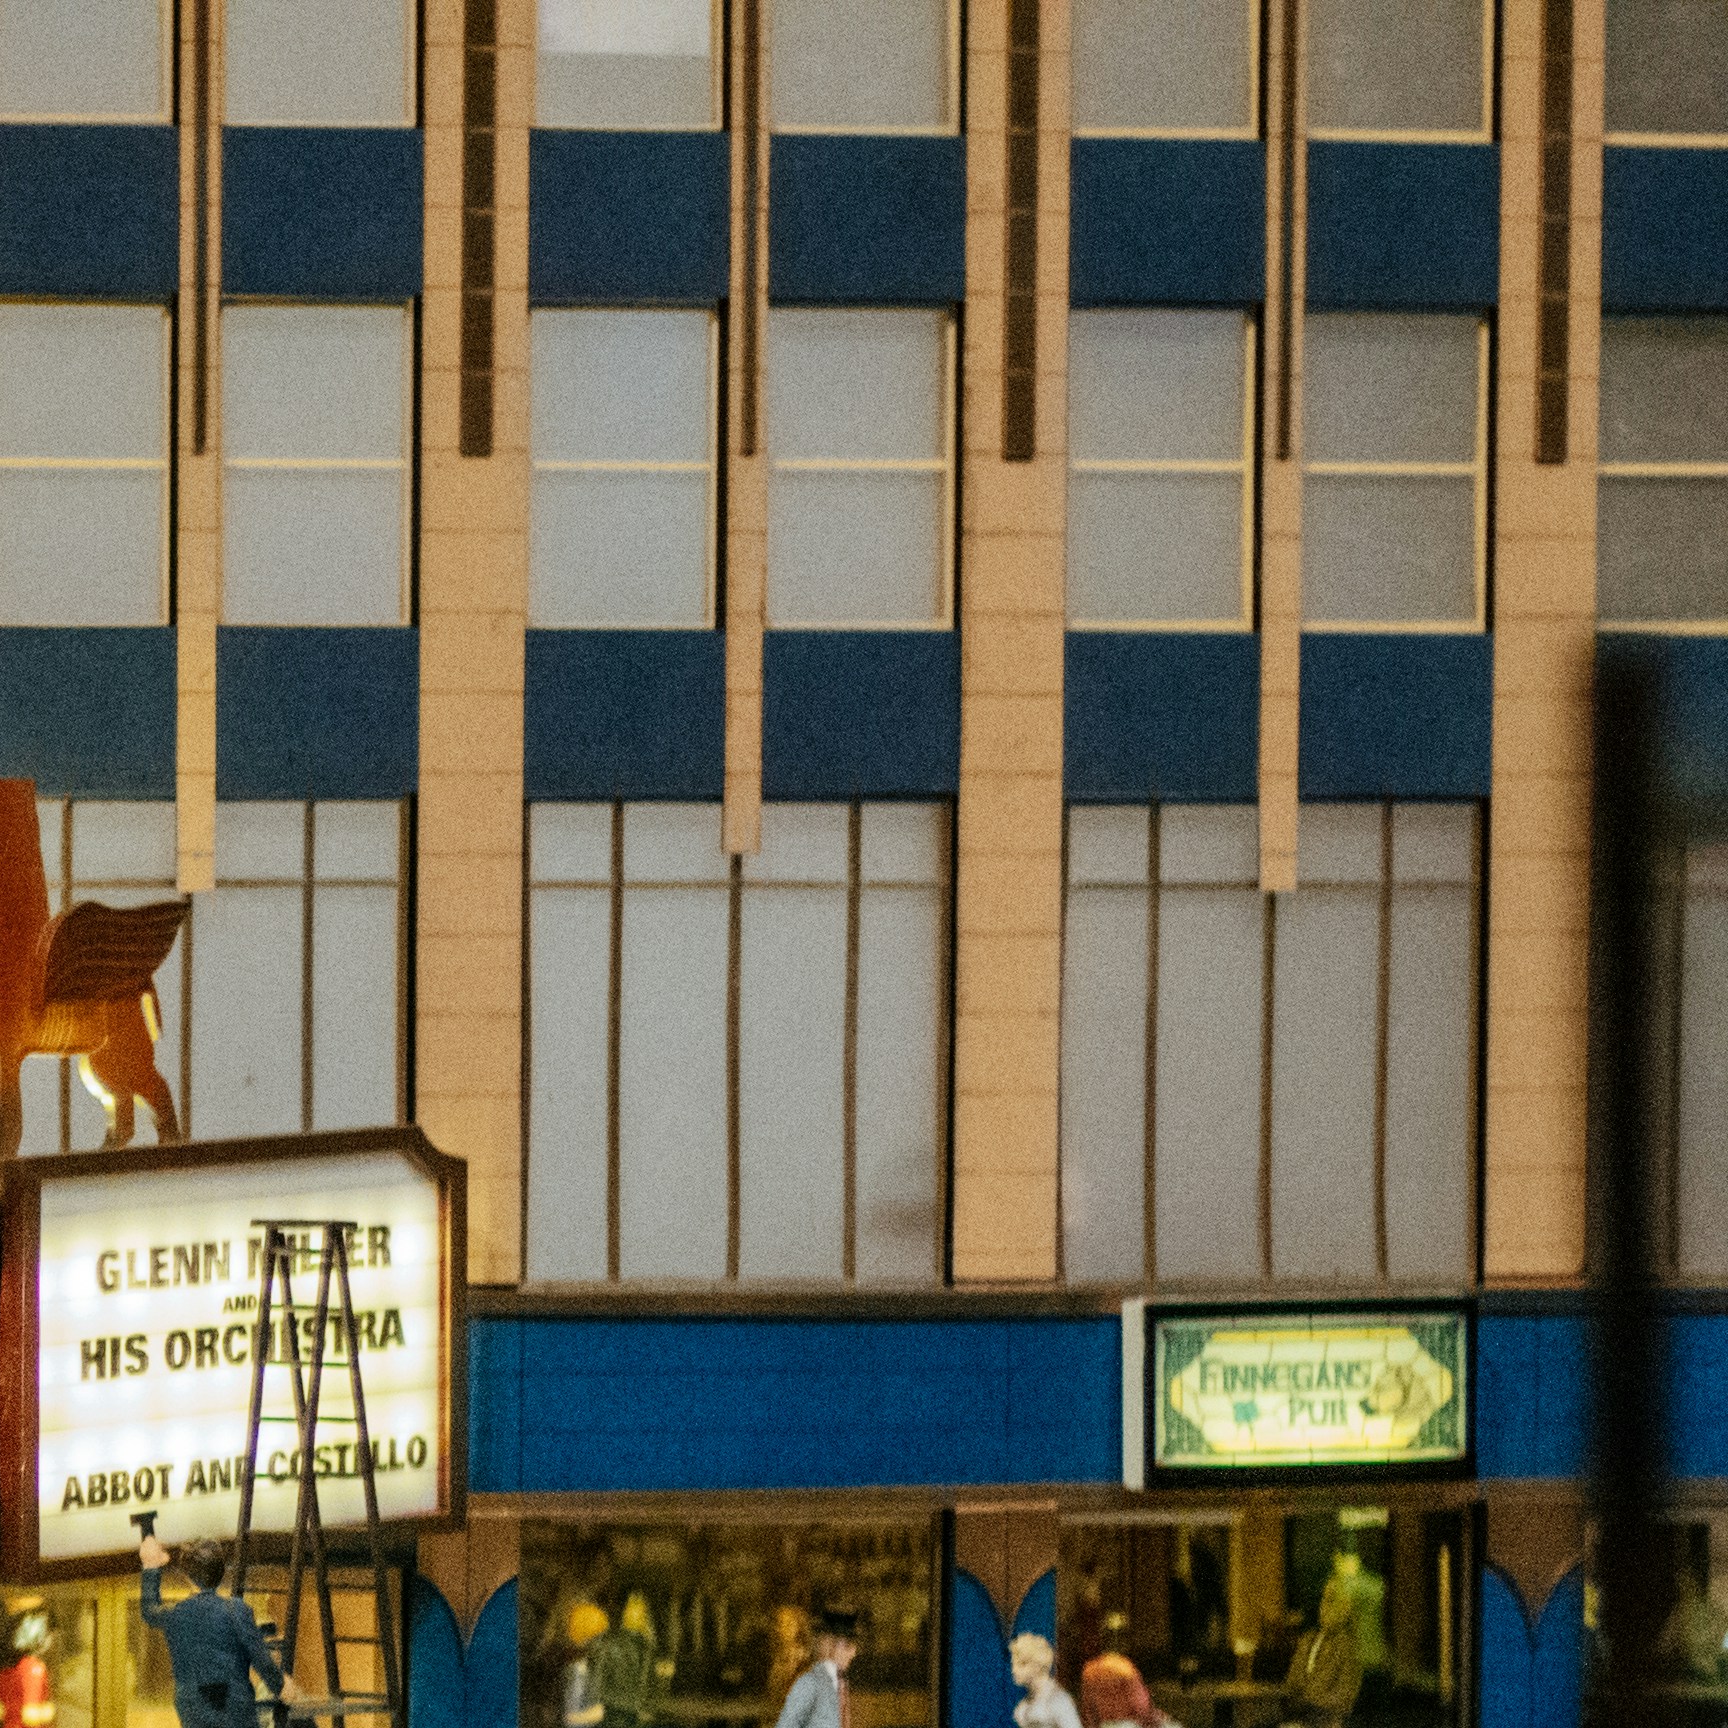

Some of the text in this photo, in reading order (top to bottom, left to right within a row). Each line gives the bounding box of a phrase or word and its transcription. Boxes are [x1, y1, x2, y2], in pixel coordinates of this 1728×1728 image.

[95, 1224, 393, 1294] GLENN ILER
[223, 1294, 258, 1315] AND
[79, 1331, 150, 1383] HIS
[60, 1463, 174, 1512] ABBOT
